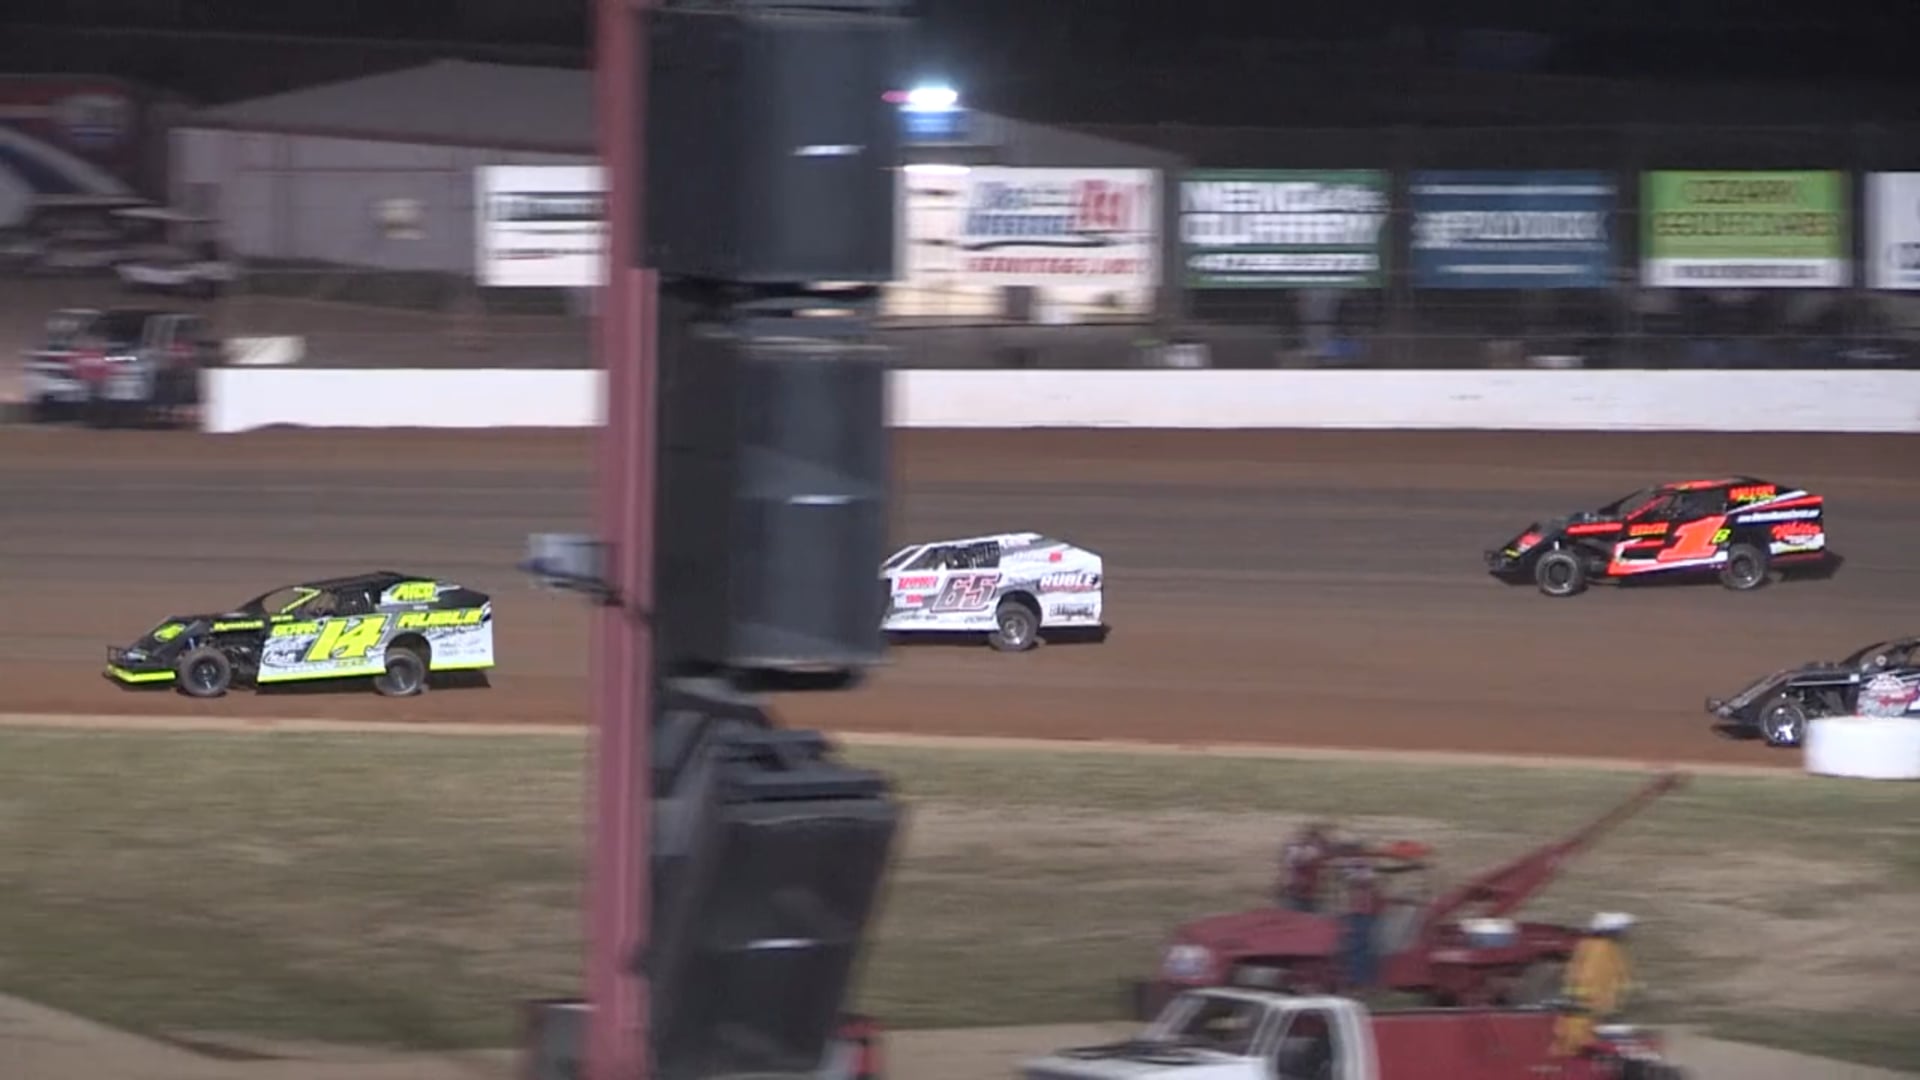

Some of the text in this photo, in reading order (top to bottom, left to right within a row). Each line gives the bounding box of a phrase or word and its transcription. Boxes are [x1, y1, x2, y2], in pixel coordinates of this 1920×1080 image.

[1656, 515, 1727, 562] 1
[930, 573, 1002, 613] 65
[306, 614, 387, 662] 14
